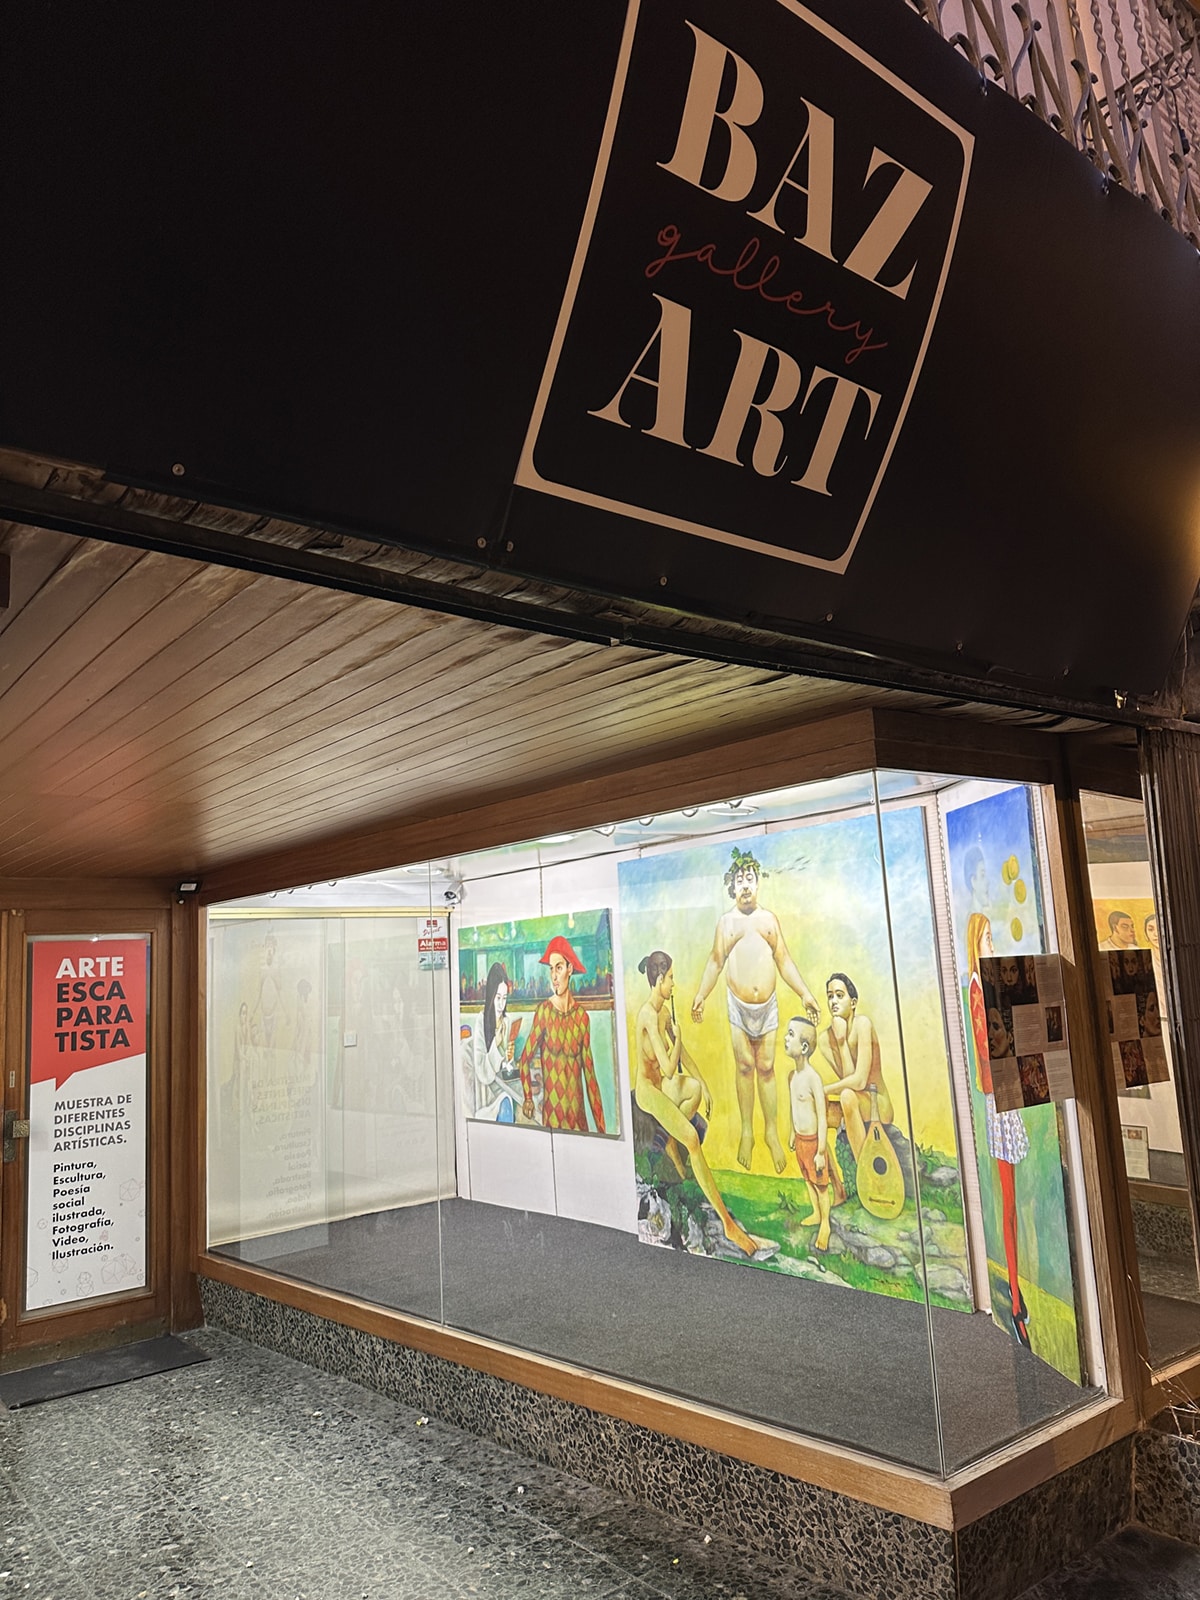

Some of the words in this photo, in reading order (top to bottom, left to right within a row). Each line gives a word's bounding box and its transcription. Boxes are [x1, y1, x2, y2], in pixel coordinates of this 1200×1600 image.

[656, 19, 934, 300] BAZ
[645, 224, 888, 364] gallery
[587, 293, 882, 496] ART
[420, 939, 446, 947] Alarma
[55, 956, 124, 979] ARTE
[56, 980, 126, 1003] ESCA
[56, 1003, 134, 1028] PARA
[54, 1028, 131, 1053] TISTA
[54, 1096, 113, 1111] MUESTRA
[117, 1094, 132, 1104] DE
[54, 1108, 125, 1125] DIFERENTES
[54, 1120, 131, 1138] DISCIPLINAS
[53, 1134, 127, 1152] ARTÍSTICAS.
[53, 1161, 97, 1173] Pintura,
[53, 1172, 106, 1185] Escultura,
[53, 1184, 90, 1197] Poesía
[52, 1196, 85, 1210] social
[52, 1206, 105, 1222] ilustrada,
[52, 1217, 114, 1235] Fotografía,
[52, 1235, 89, 1247] Video,
[52, 1242, 114, 1260] Ilustración.
